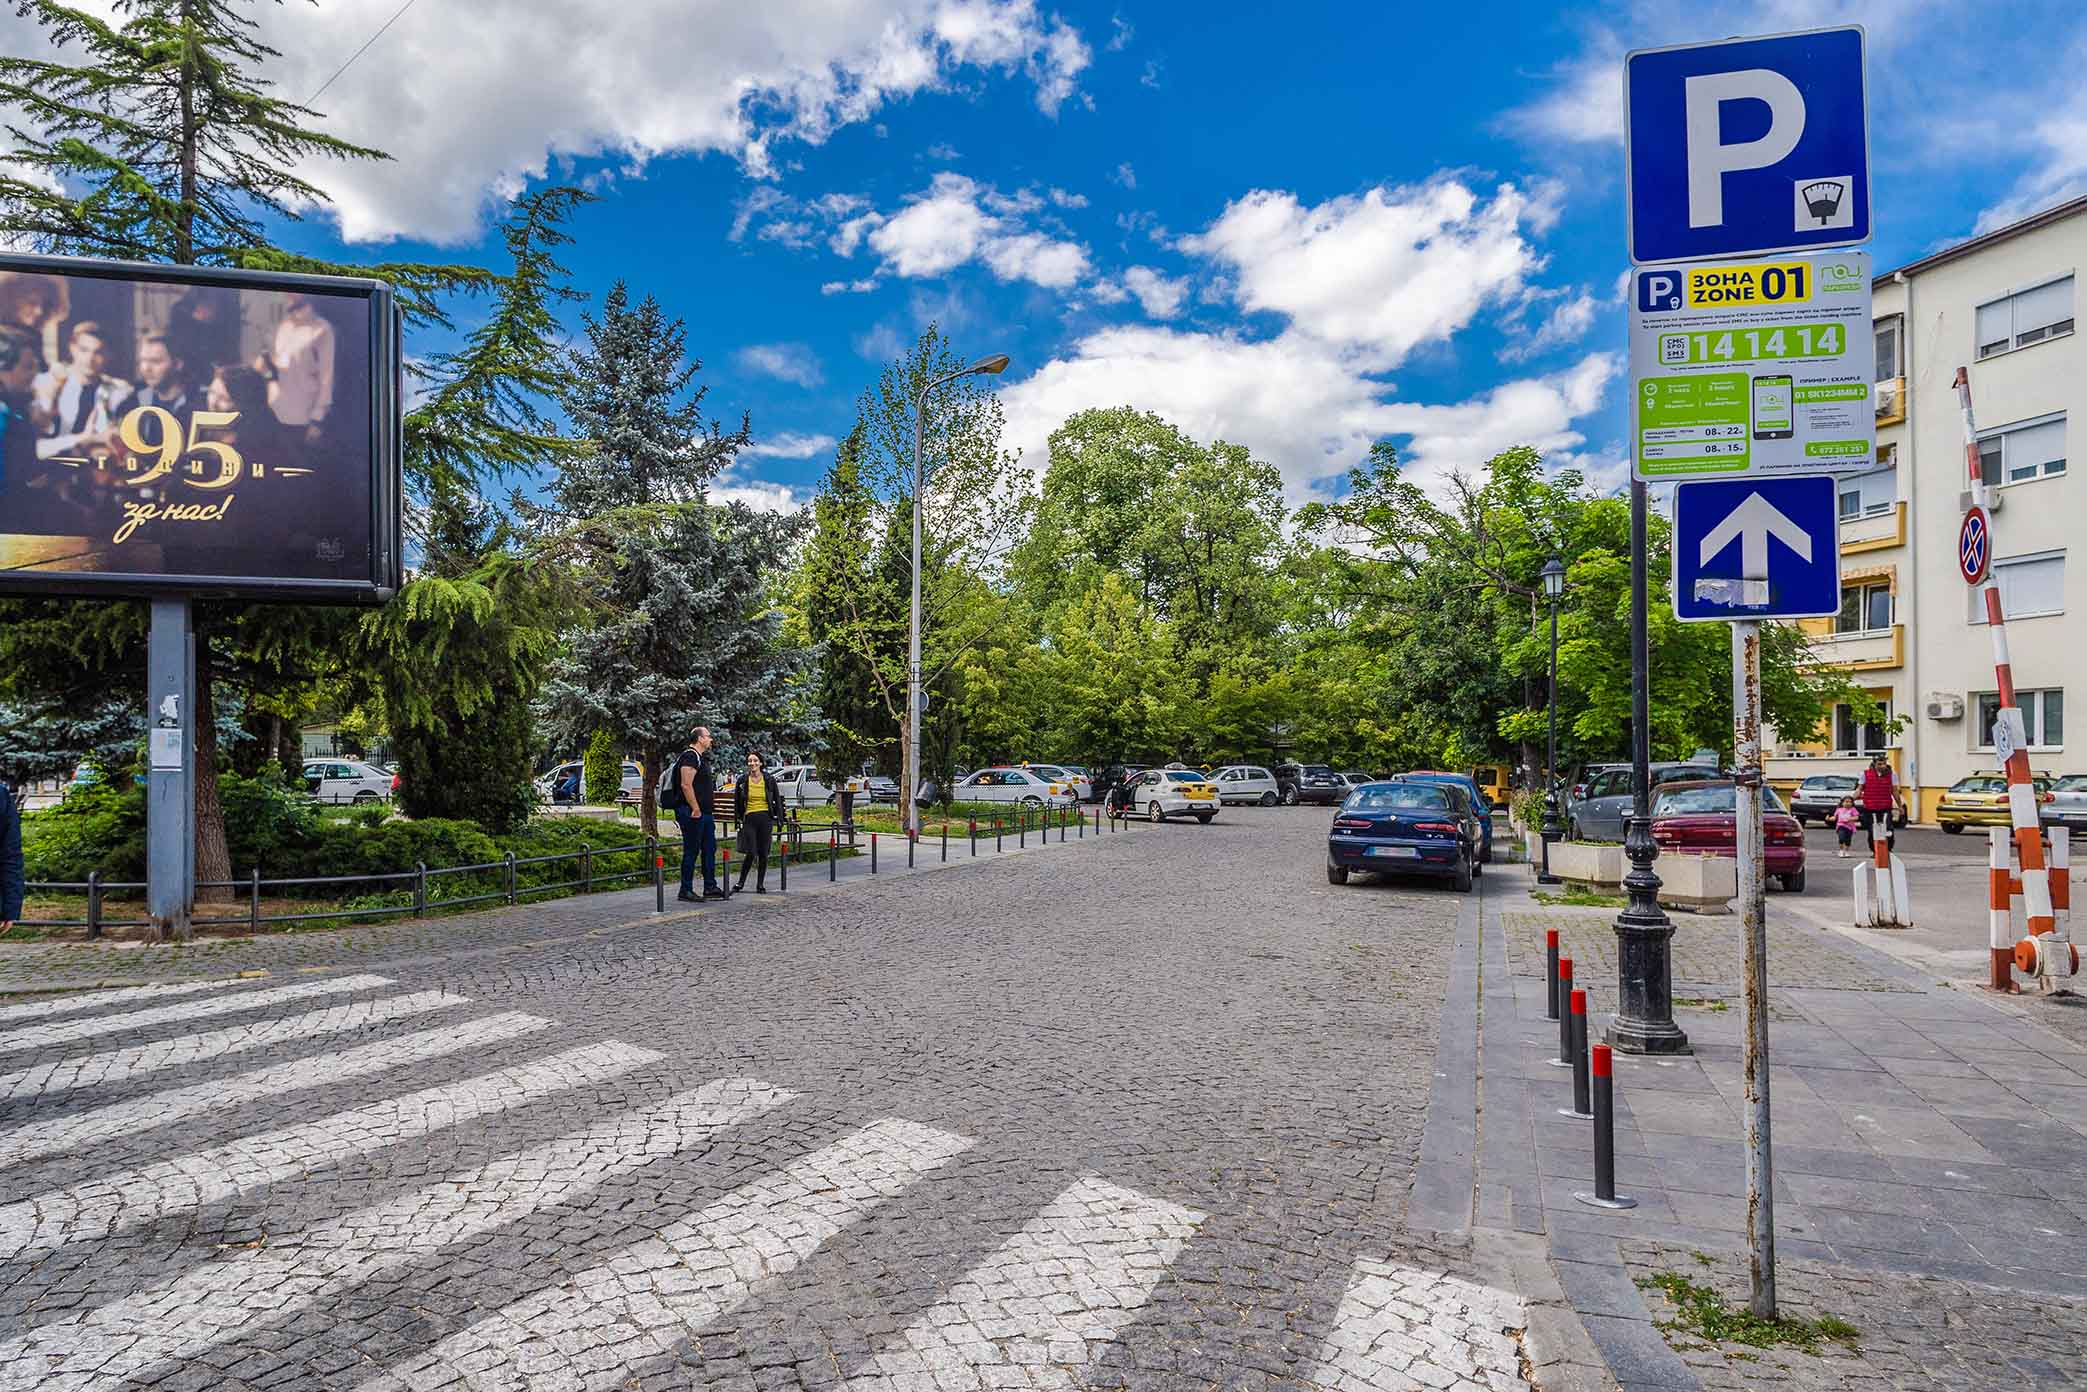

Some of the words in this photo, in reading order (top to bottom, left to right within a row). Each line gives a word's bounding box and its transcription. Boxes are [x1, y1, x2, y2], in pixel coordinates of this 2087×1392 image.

[1685, 68, 1806, 229] P
[1649, 276, 1673, 306] P
[1693, 272, 1755, 287] ЗОНА
[1693, 287, 1755, 303] ZONE
[1761, 266, 1805, 300] 01
[1693, 332, 1735, 361] 14
[1745, 329, 1787, 358] 14
[1796, 326, 1840, 355] 14
[119, 405, 243, 488] 95
[161, 494, 235, 521] нас!
